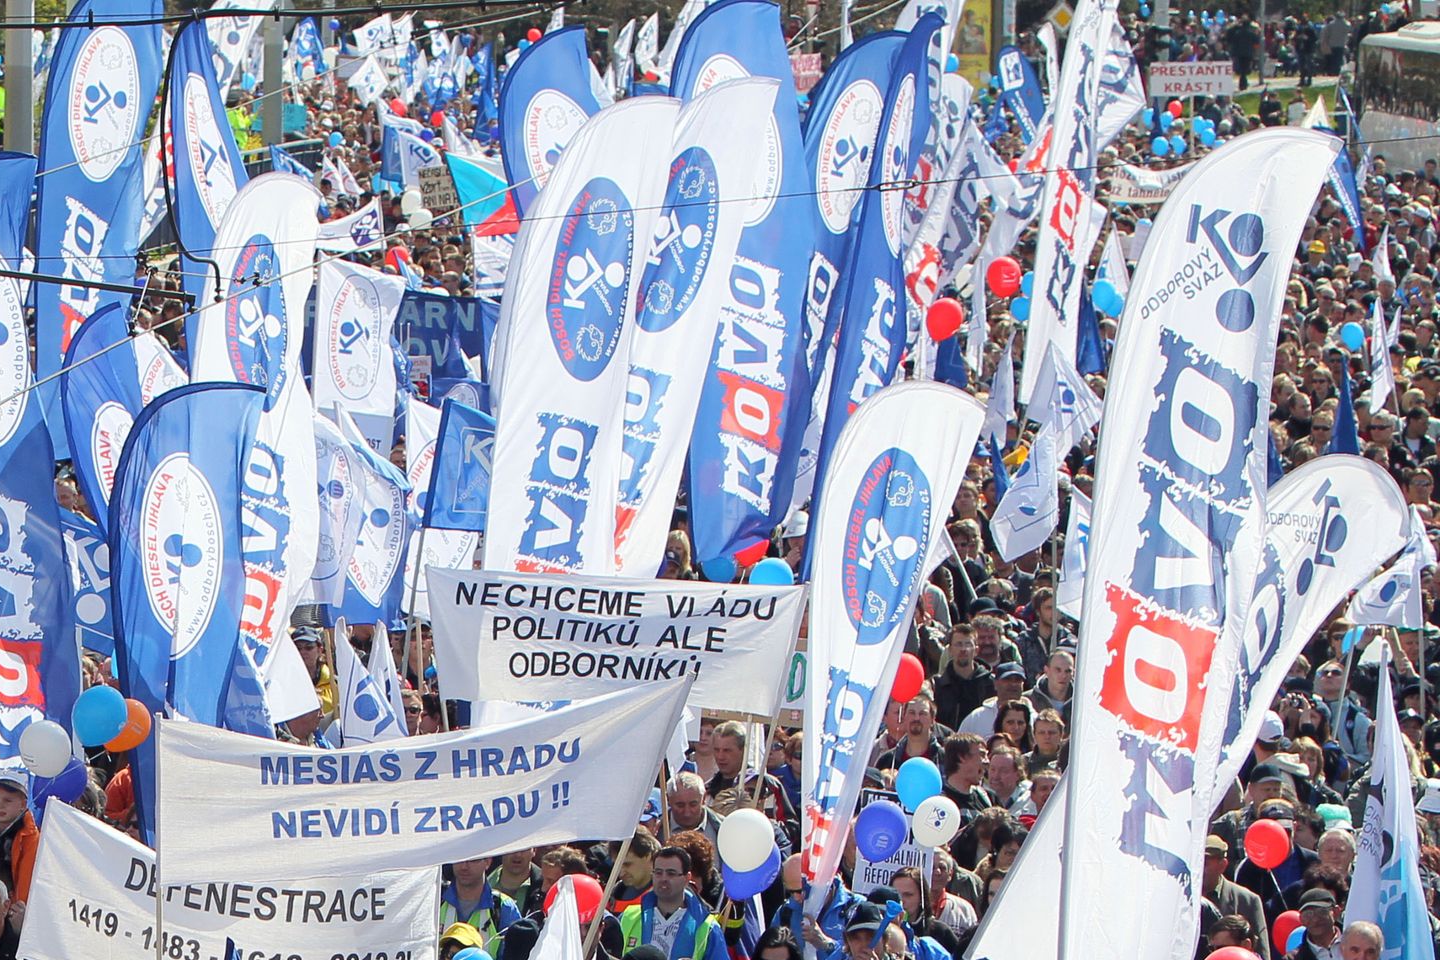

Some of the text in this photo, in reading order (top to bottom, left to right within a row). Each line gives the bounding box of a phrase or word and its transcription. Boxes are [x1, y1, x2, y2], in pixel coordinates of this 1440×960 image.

[78, 37, 103, 79] JIHLAVA
[73, 83, 84, 125] DIESEL
[1164, 79, 1213, 93] KRÁST
[821, 92, 857, 217] BOSCH DIESEL JIHLAVA
[675, 181, 716, 312] www.odborybosch.cz
[550, 191, 591, 361] BOSCH DIESEL JIHLAVA
[1141, 246, 1214, 320] ODBOROVÝ
[1181, 262, 1223, 300] SVAZ
[331, 319, 339, 352] DIESEL
[332, 355, 346, 389] BOSCH
[717, 258, 784, 510] KOVO
[153, 473, 174, 532] JIHLAVA
[861, 455, 893, 507] JIHLAVA
[148, 533, 160, 588] DIESEL
[1295, 530, 1318, 545] SVAZ
[186, 493, 217, 637] www.odborybosch.cz
[455, 581, 778, 621] NECHCEME VLÁDU
[1112, 340, 1252, 880] KOVO
[655, 624, 728, 653] ALE
[260, 735, 582, 785] MESIÁŠ Z HRADU
[271, 781, 570, 840] NEVIDÍ ZRADU !!
[68, 898, 119, 937] 1419
